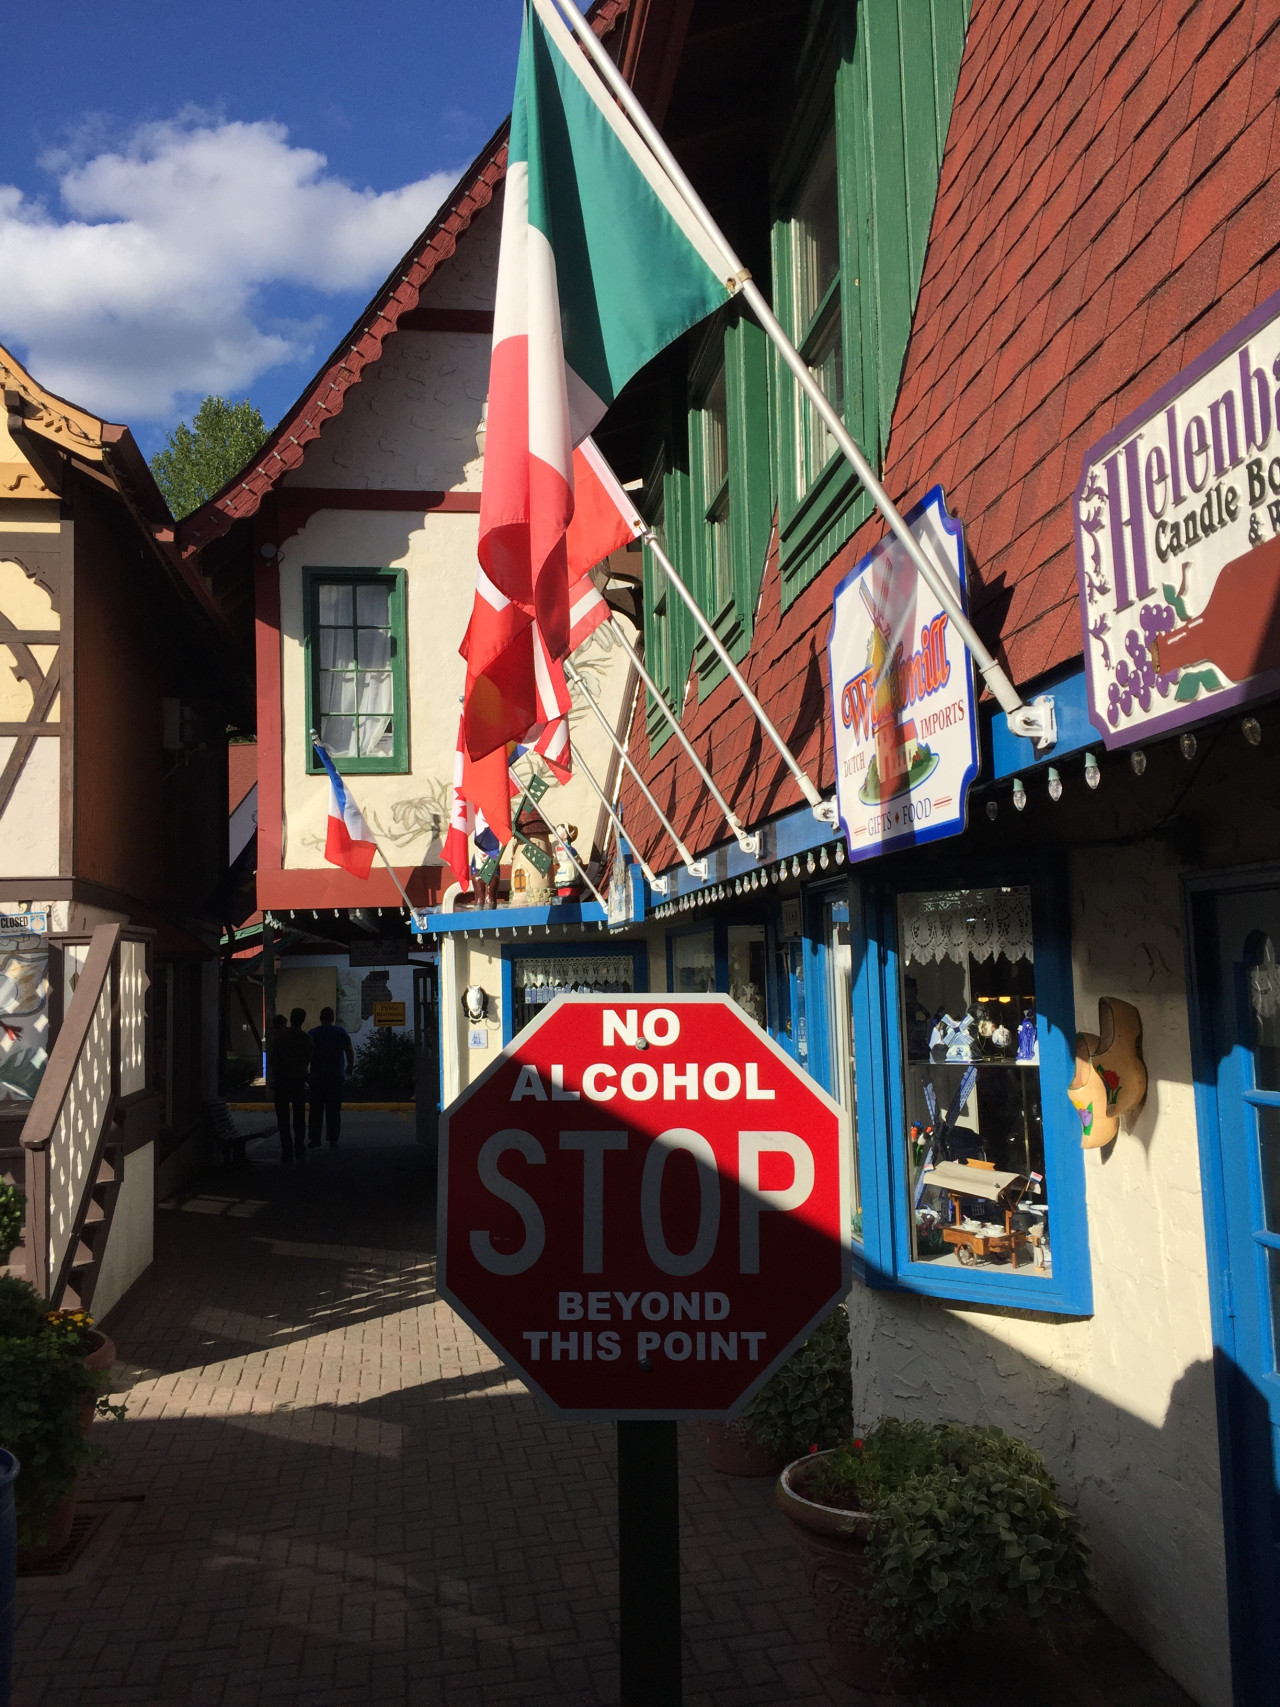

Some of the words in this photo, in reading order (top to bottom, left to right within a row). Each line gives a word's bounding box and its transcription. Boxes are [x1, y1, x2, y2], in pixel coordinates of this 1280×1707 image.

[1155, 481, 1239, 562] Candle
[1247, 512, 1262, 547] &
[842, 610, 951, 746] Widmill
[844, 752, 865, 778] DUTCH
[920, 700, 965, 740] IMPORTS
[867, 811, 892, 836] GIFTS
[902, 797, 932, 825] FOOD
[0, 916, 28, 928] CLOSED
[602, 1009, 681, 1047] NO
[510, 1062, 776, 1102] ALCOHOL
[469, 1127, 815, 1277] STOP
[557, 1291, 731, 1321] BEYOND
[522, 1331, 622, 1361] THIS
[636, 1331, 767, 1361] POINT
